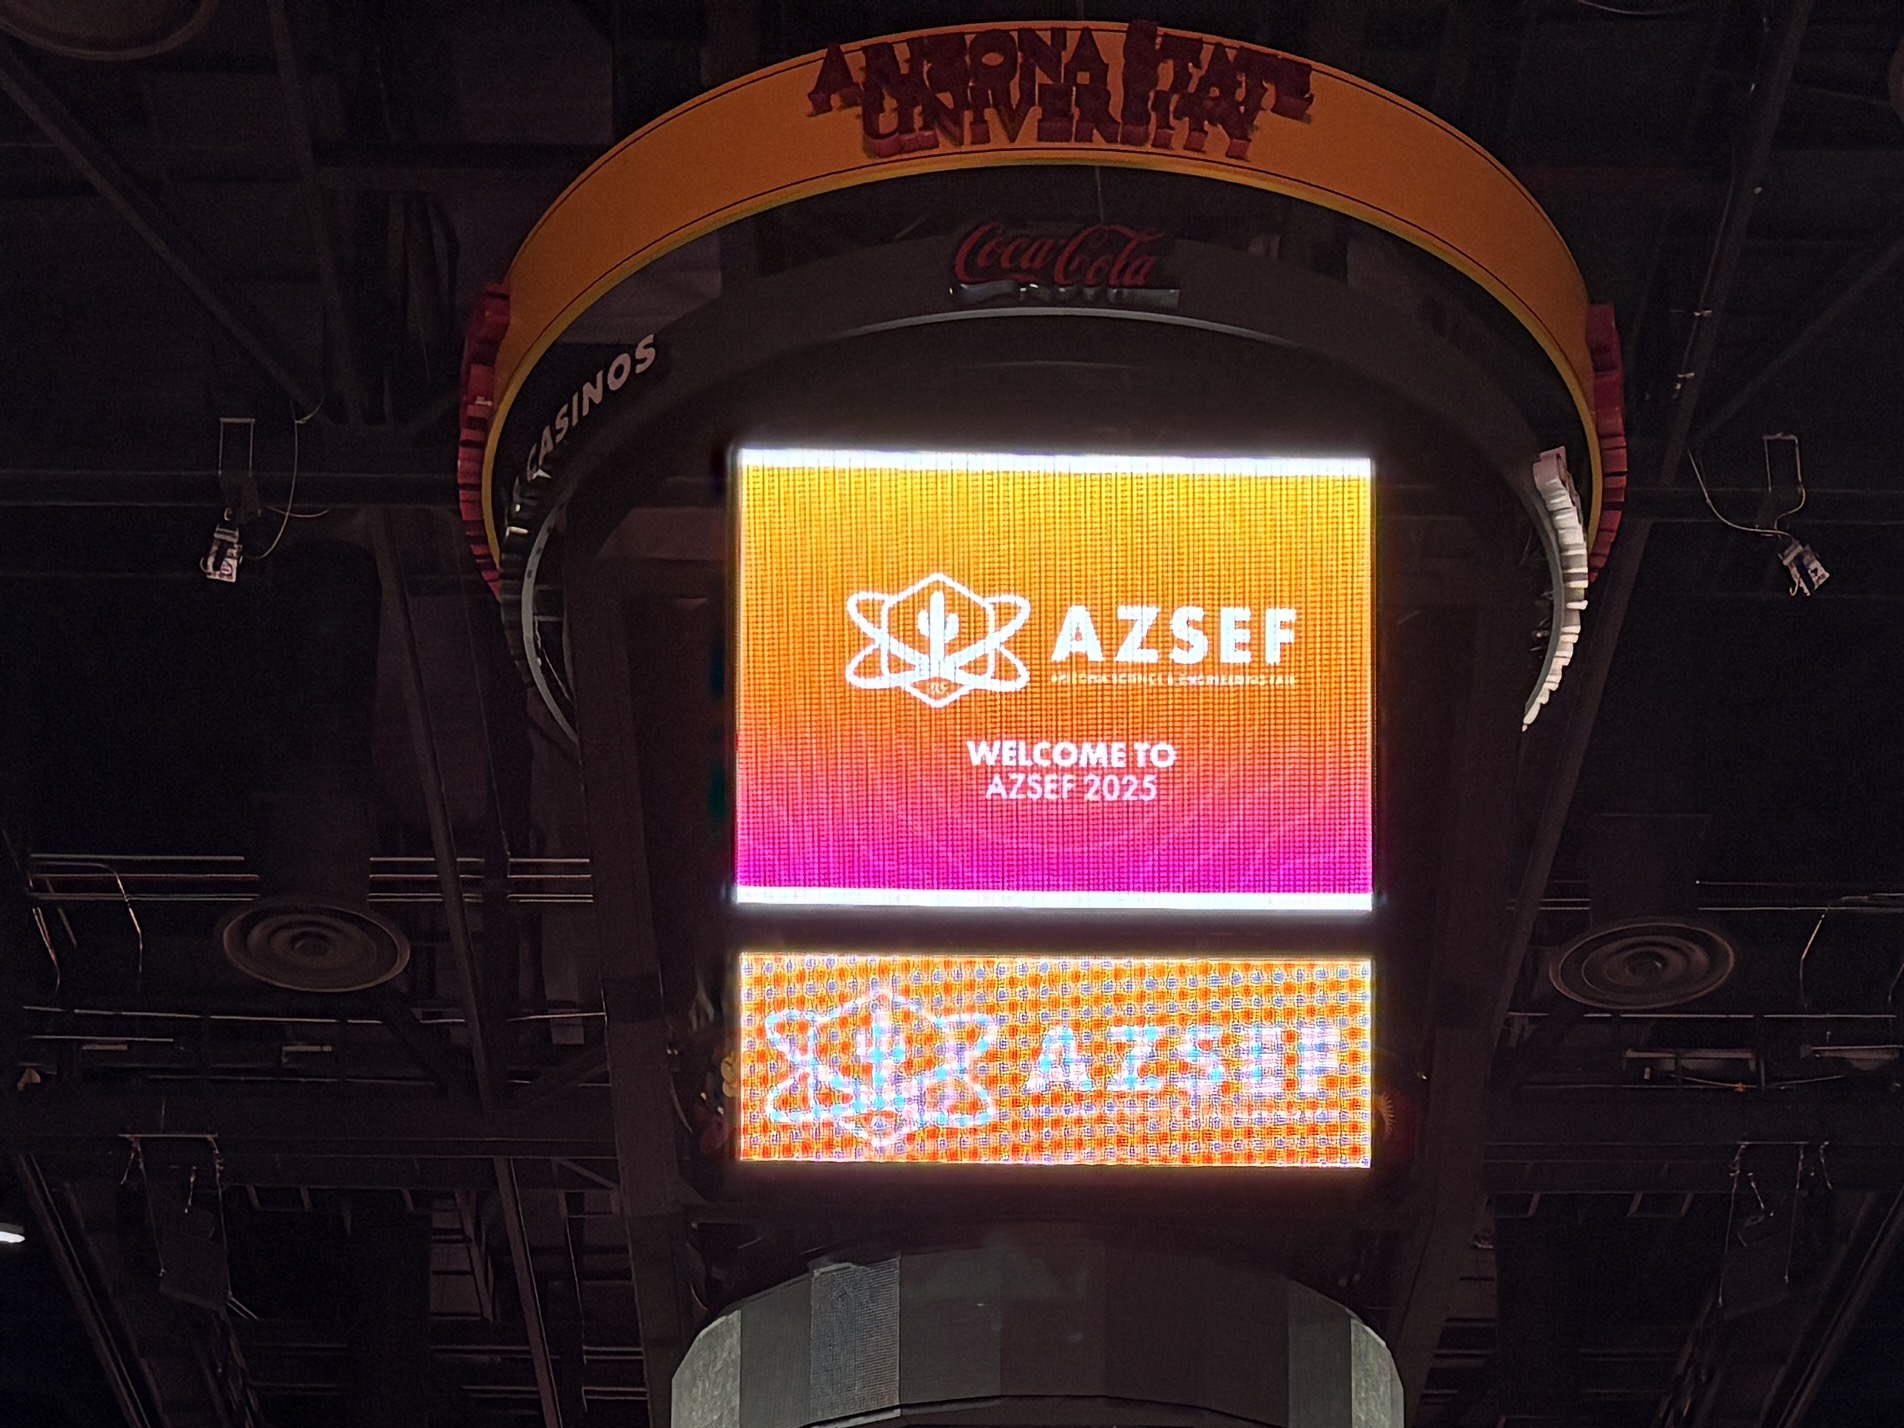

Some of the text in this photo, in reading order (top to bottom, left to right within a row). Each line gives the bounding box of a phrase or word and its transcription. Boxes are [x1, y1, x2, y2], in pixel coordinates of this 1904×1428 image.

[527, 334, 656, 481] CASINOS
[1051, 605, 1297, 665] AZSEF
[967, 741, 1177, 769] WELCOME TO
[986, 774, 1157, 801] AZSEF 2025
[1025, 1025, 1338, 1094] AZSEF
